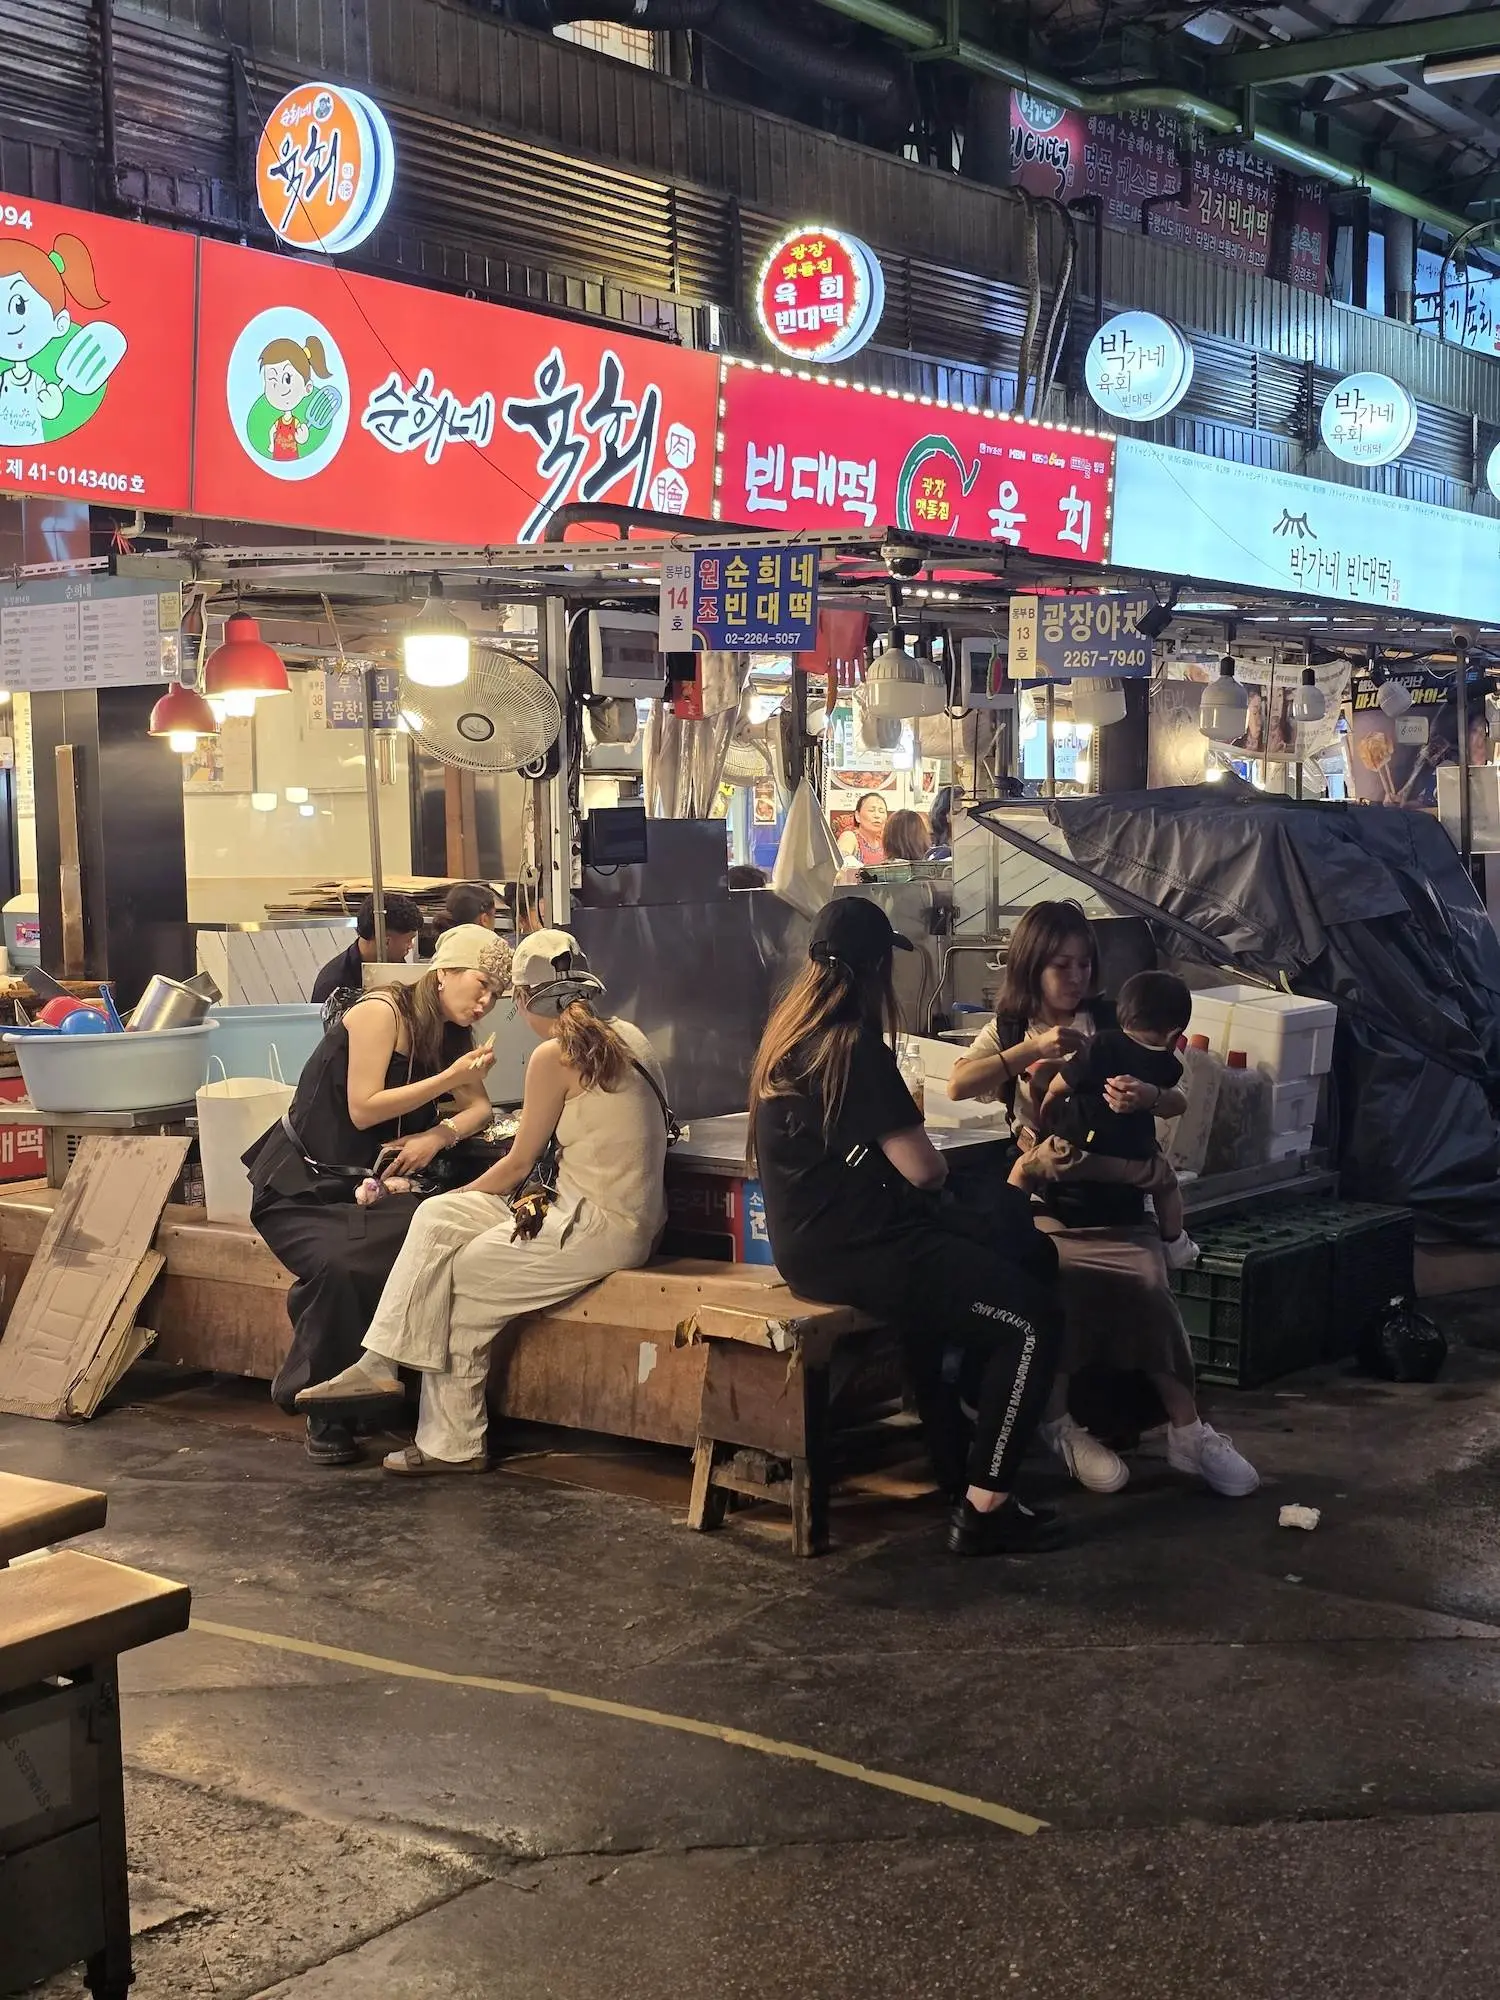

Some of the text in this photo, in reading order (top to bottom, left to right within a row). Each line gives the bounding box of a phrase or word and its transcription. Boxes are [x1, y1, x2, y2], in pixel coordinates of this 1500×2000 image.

[1083, 143, 1112, 187] 명품
[268, 124, 339, 232] 육회
[790, 240, 826, 260] 광장
[774, 275, 843, 306] 육 회
[775, 302, 844, 334] 빈대떡
[1099, 329, 1166, 372] 박가네
[1096, 371, 1132, 394] 육회
[1121, 392, 1153, 409] 빈대떡
[1335, 388, 1395, 425] 박가네
[1330, 424, 1363, 444] 육회
[366, 354, 658, 542] 순희네 육회
[1008, 449, 1026, 460] MBN
[1352, 444, 1383, 457] 빈대떡
[6, 459, 23, 481] 제
[745, 441, 878, 527] 빈대떡
[921, 477, 946, 497] 광장
[988, 480, 1093, 553] 육 회
[664, 565, 691, 579] 동부B
[724, 553, 814, 589] 순희네
[1290, 545, 1342, 588] 박가네
[1347, 554, 1393, 602] 빈대떡
[64, 583, 92, 600] 순희네
[667, 587, 688, 610] 14
[724, 591, 812, 626] 빈대떡
[1011, 608, 1035, 620] 동부B
[671, 615, 683, 631] 호
[725, 632, 801, 645] 02-2264-5057
[1016, 627, 1030, 640] 13
[1015, 647, 1028, 661] 호
[1063, 650, 1145, 668] 2267-7940
[312, 695, 323, 706] 38
[312, 710, 323, 720] 호
